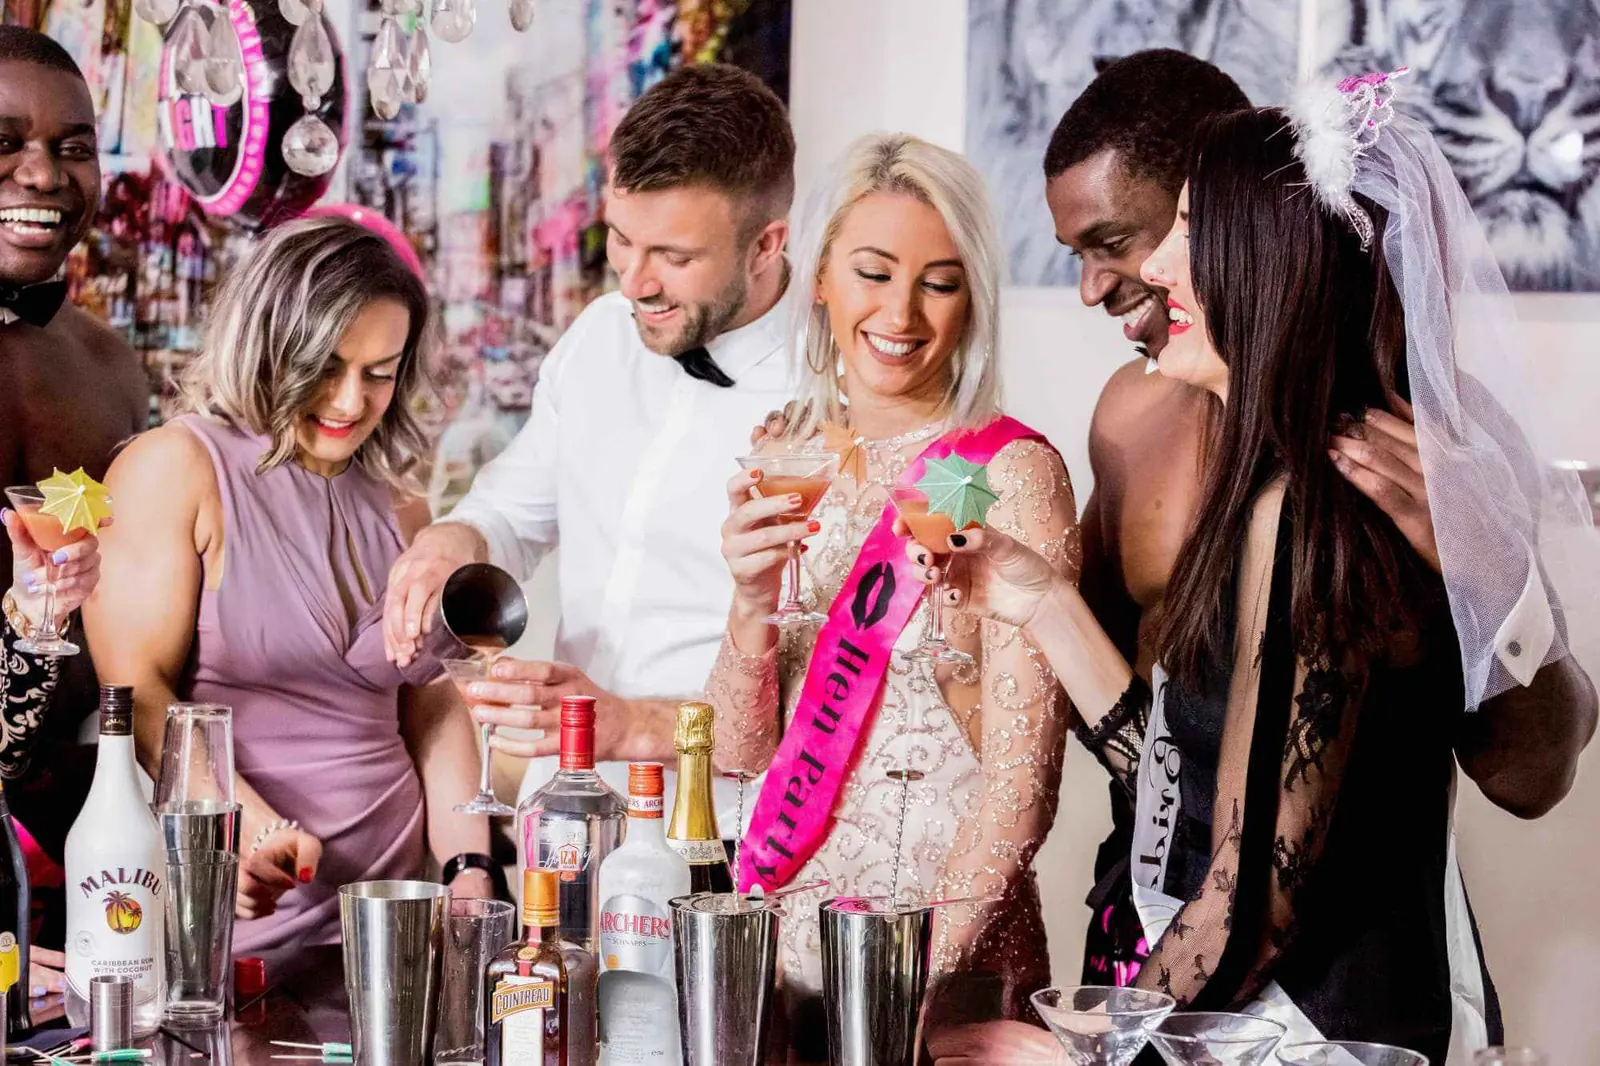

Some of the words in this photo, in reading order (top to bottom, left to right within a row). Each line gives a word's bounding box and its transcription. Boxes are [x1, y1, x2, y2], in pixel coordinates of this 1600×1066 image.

[811, 636, 870, 738] Hen
[752, 749, 826, 888] Party
[79, 867, 163, 899] MALIBU
[600, 911, 671, 939] ARCHERS
[117, 965, 152, 973] COCONUT
[495, 988, 550, 1016] COINTREAU
